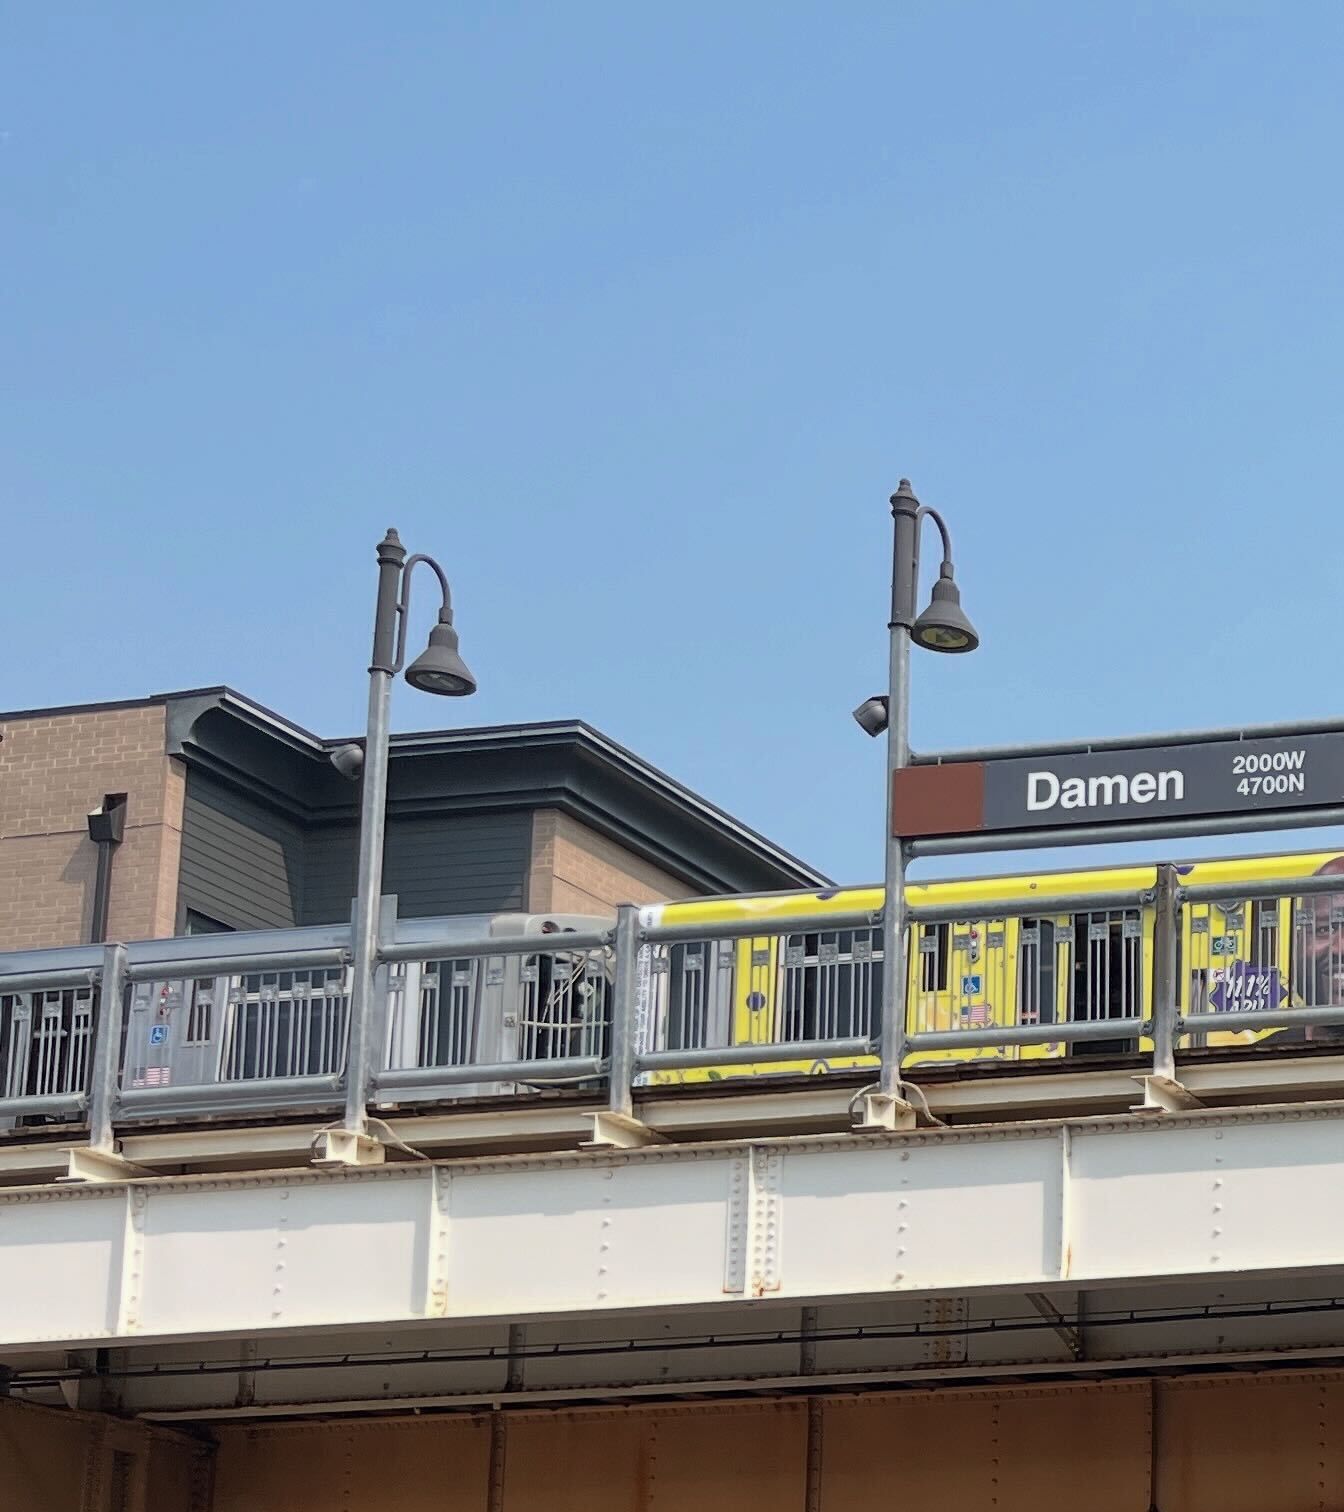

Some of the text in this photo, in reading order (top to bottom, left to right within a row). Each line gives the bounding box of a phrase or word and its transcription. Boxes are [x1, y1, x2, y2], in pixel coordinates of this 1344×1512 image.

[1232, 751, 1306, 774] 2000W
[1026, 769, 1184, 811] Damen
[1236, 773, 1305, 796] 4700N
